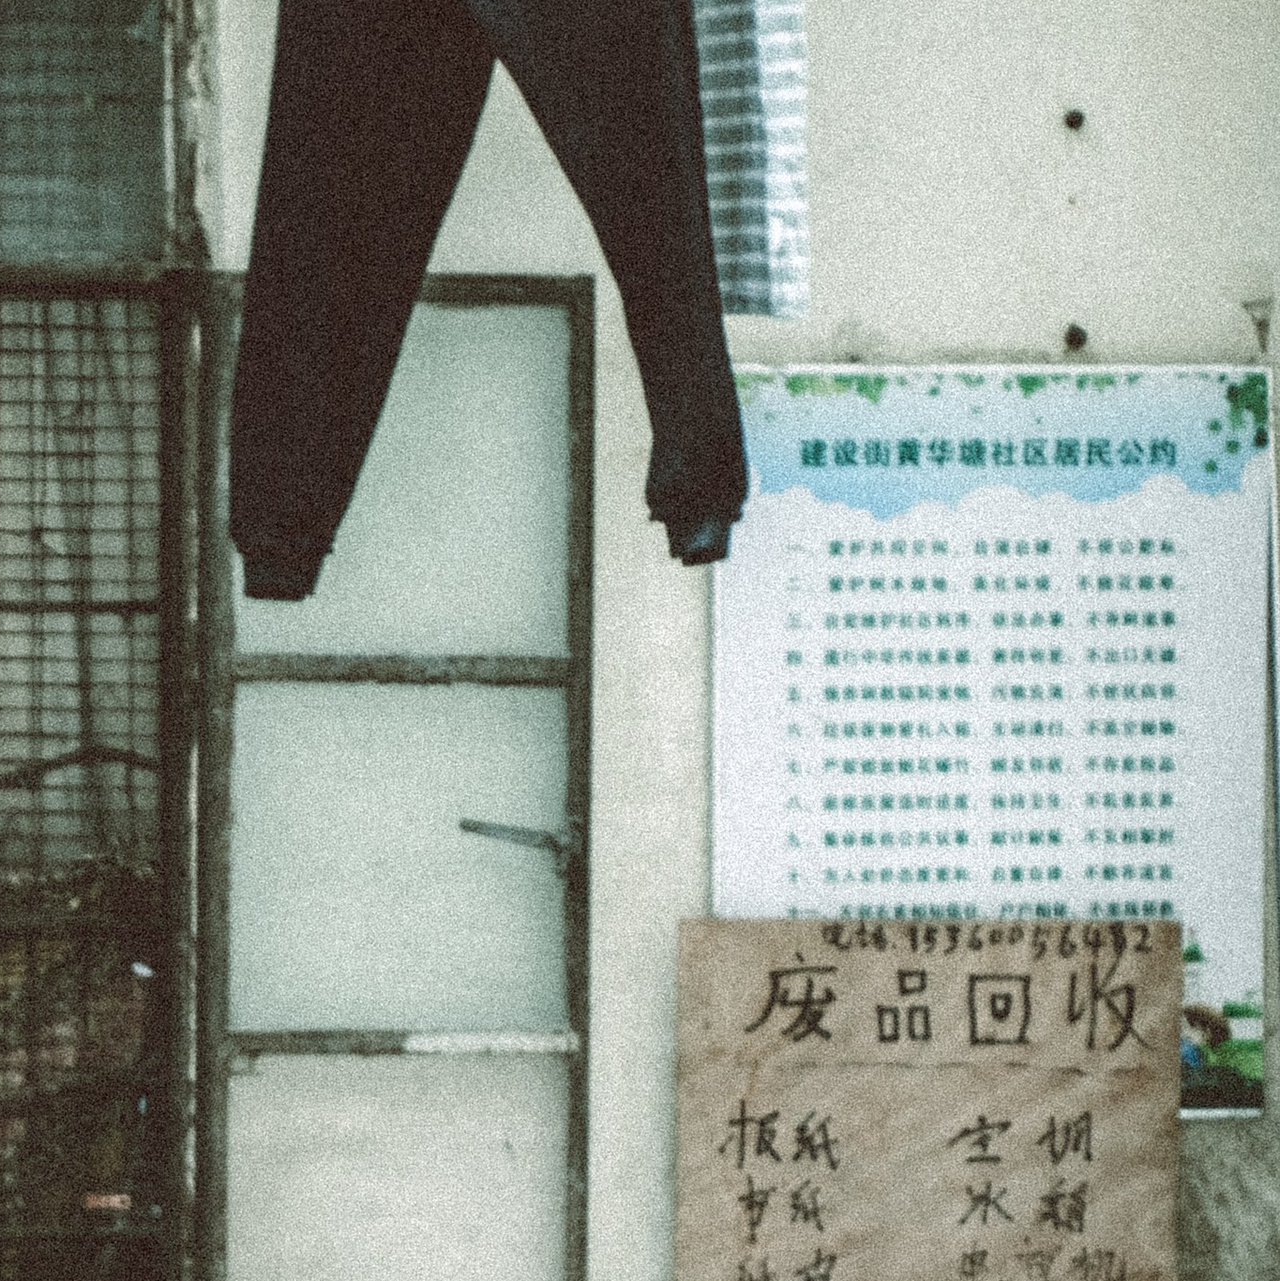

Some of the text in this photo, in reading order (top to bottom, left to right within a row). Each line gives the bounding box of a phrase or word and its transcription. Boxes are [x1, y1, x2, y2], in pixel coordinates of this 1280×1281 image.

[799, 437, 1179, 469] 建设街黄华塘社区居民公约
[744, 951, 1156, 1053] 废品回收
